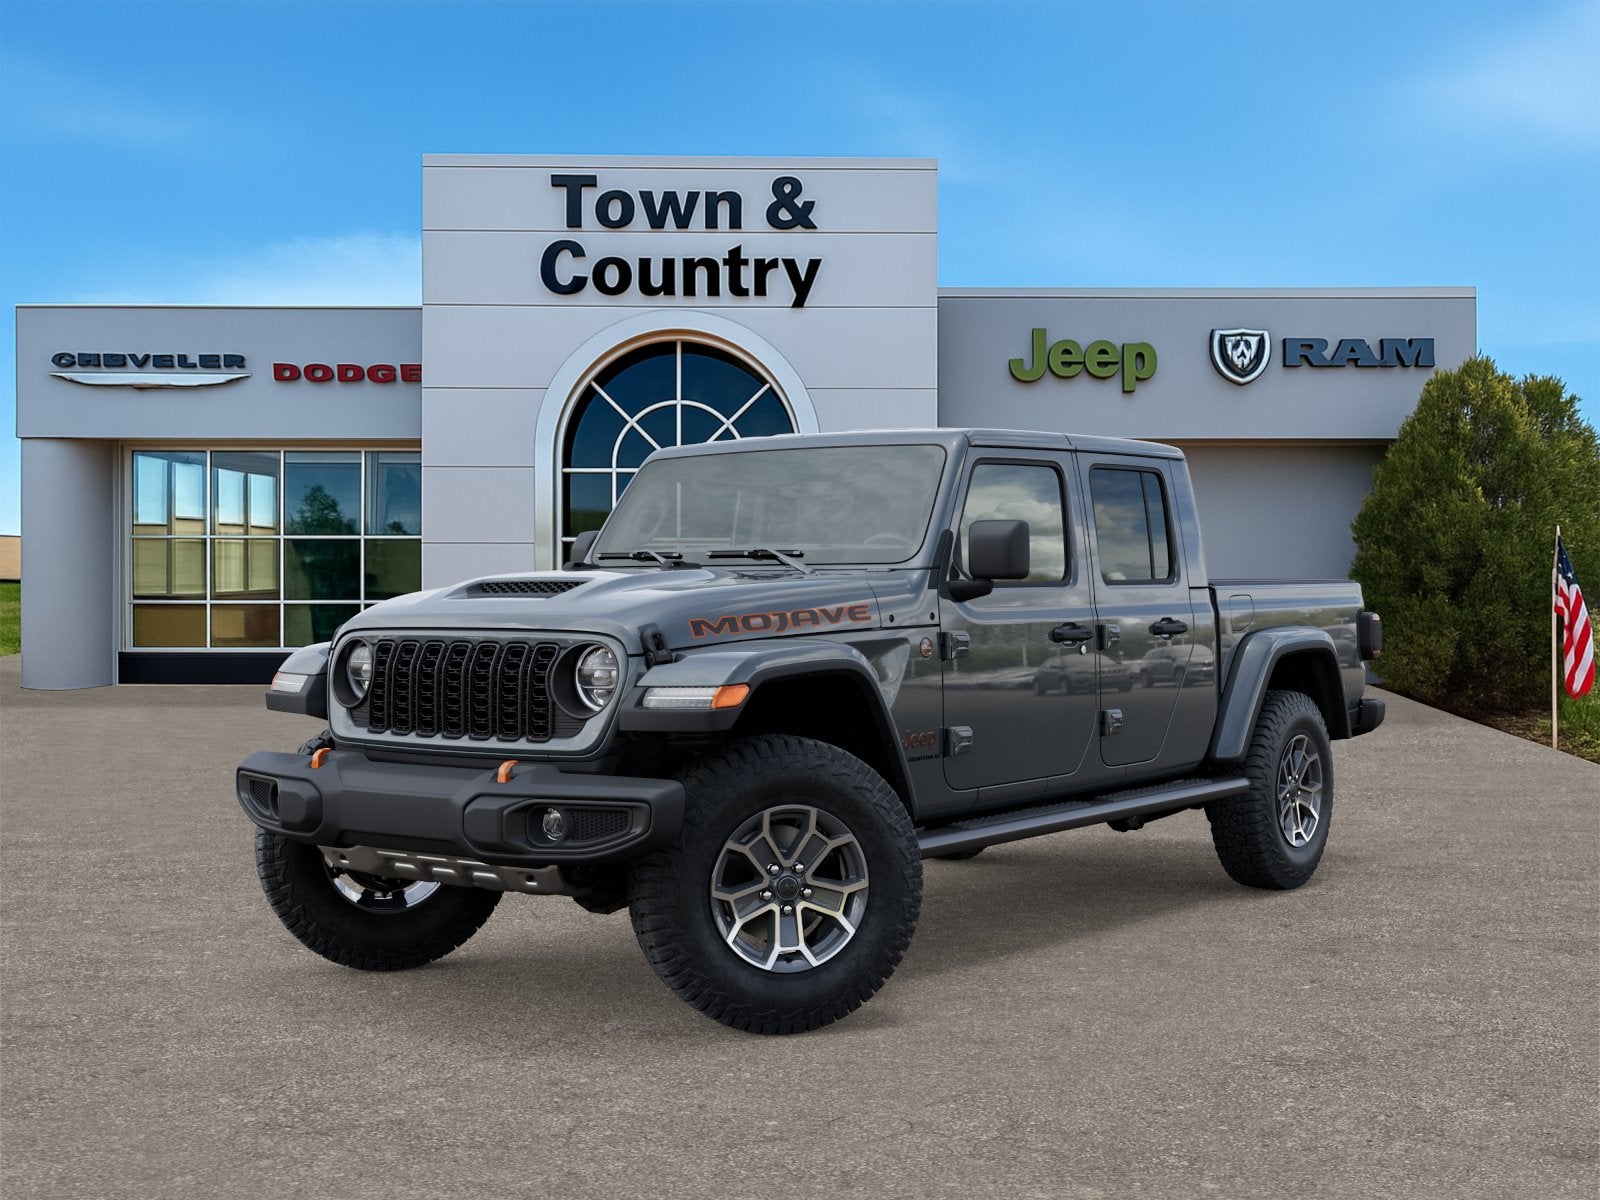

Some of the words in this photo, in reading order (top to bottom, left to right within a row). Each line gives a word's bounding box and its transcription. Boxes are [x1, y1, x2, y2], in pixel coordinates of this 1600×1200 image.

[550, 174, 743, 230] Town
[765, 175, 818, 230] &
[540, 239, 822, 309] Country
[1008, 327, 1158, 393] Jeep
[1282, 337, 1435, 368] RAM
[273, 363, 422, 383] DODGE
[688, 604, 872, 639] MOJAVE
[902, 729, 936, 751] Jeep
